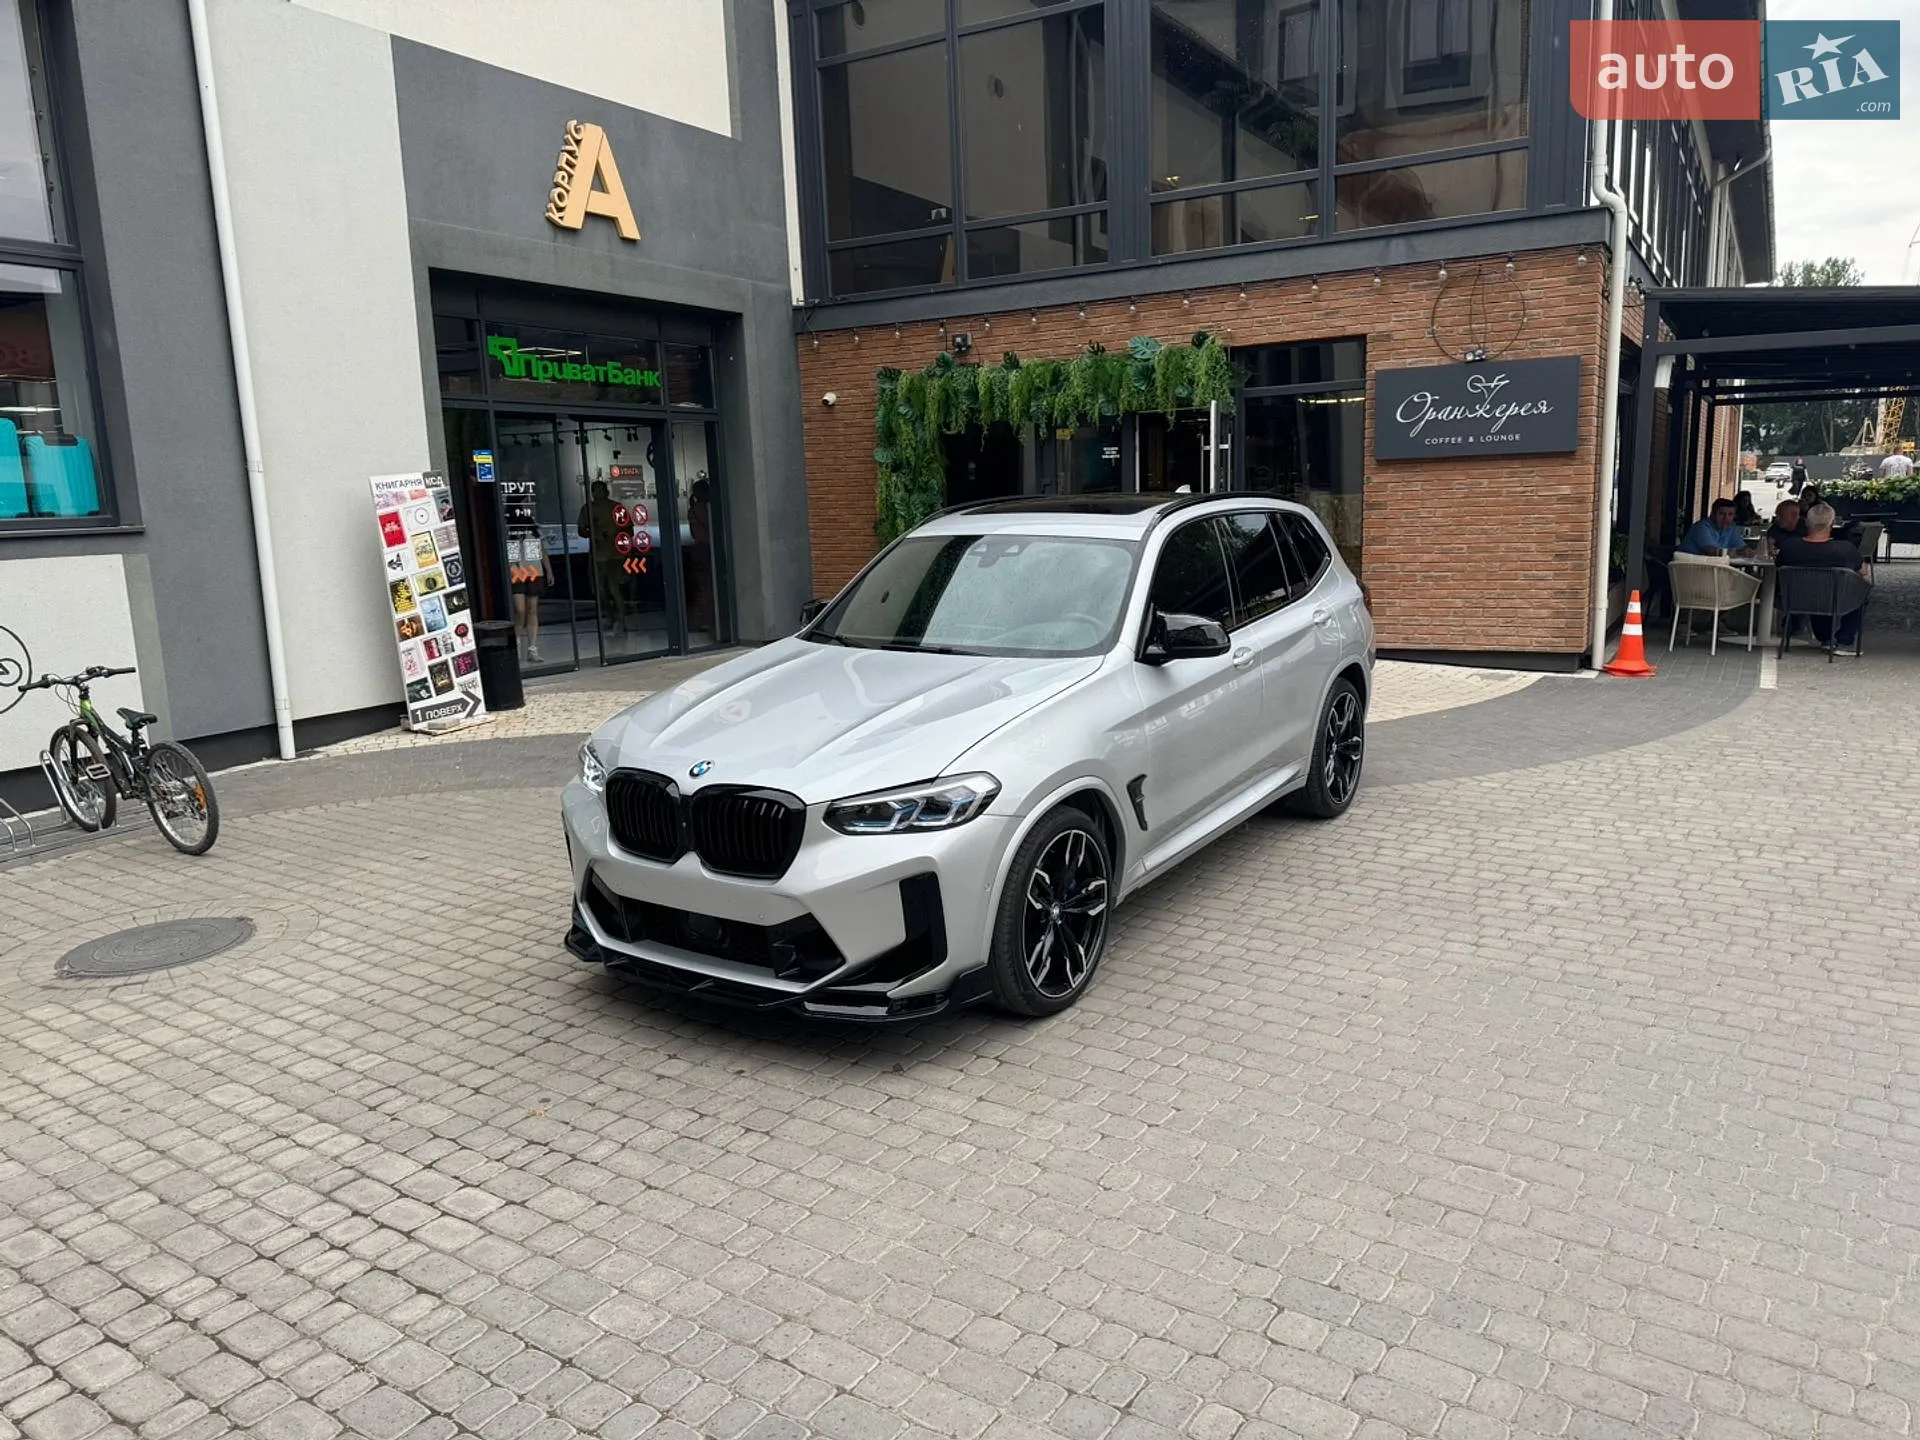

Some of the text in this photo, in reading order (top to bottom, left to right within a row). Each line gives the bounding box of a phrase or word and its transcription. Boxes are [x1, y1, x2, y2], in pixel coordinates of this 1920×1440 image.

[545, 119, 585, 227] КОРПУС
[562, 122, 641, 241] А
[517, 353, 662, 387] ПриватБанк
[1396, 390, 1555, 438] Оранжерея
[1424, 436, 1463, 445] COFFEE
[1479, 433, 1521, 443] LOUNGE
[374, 478, 424, 491] КНИГАРНЯ
[415, 709, 423, 722] 1
